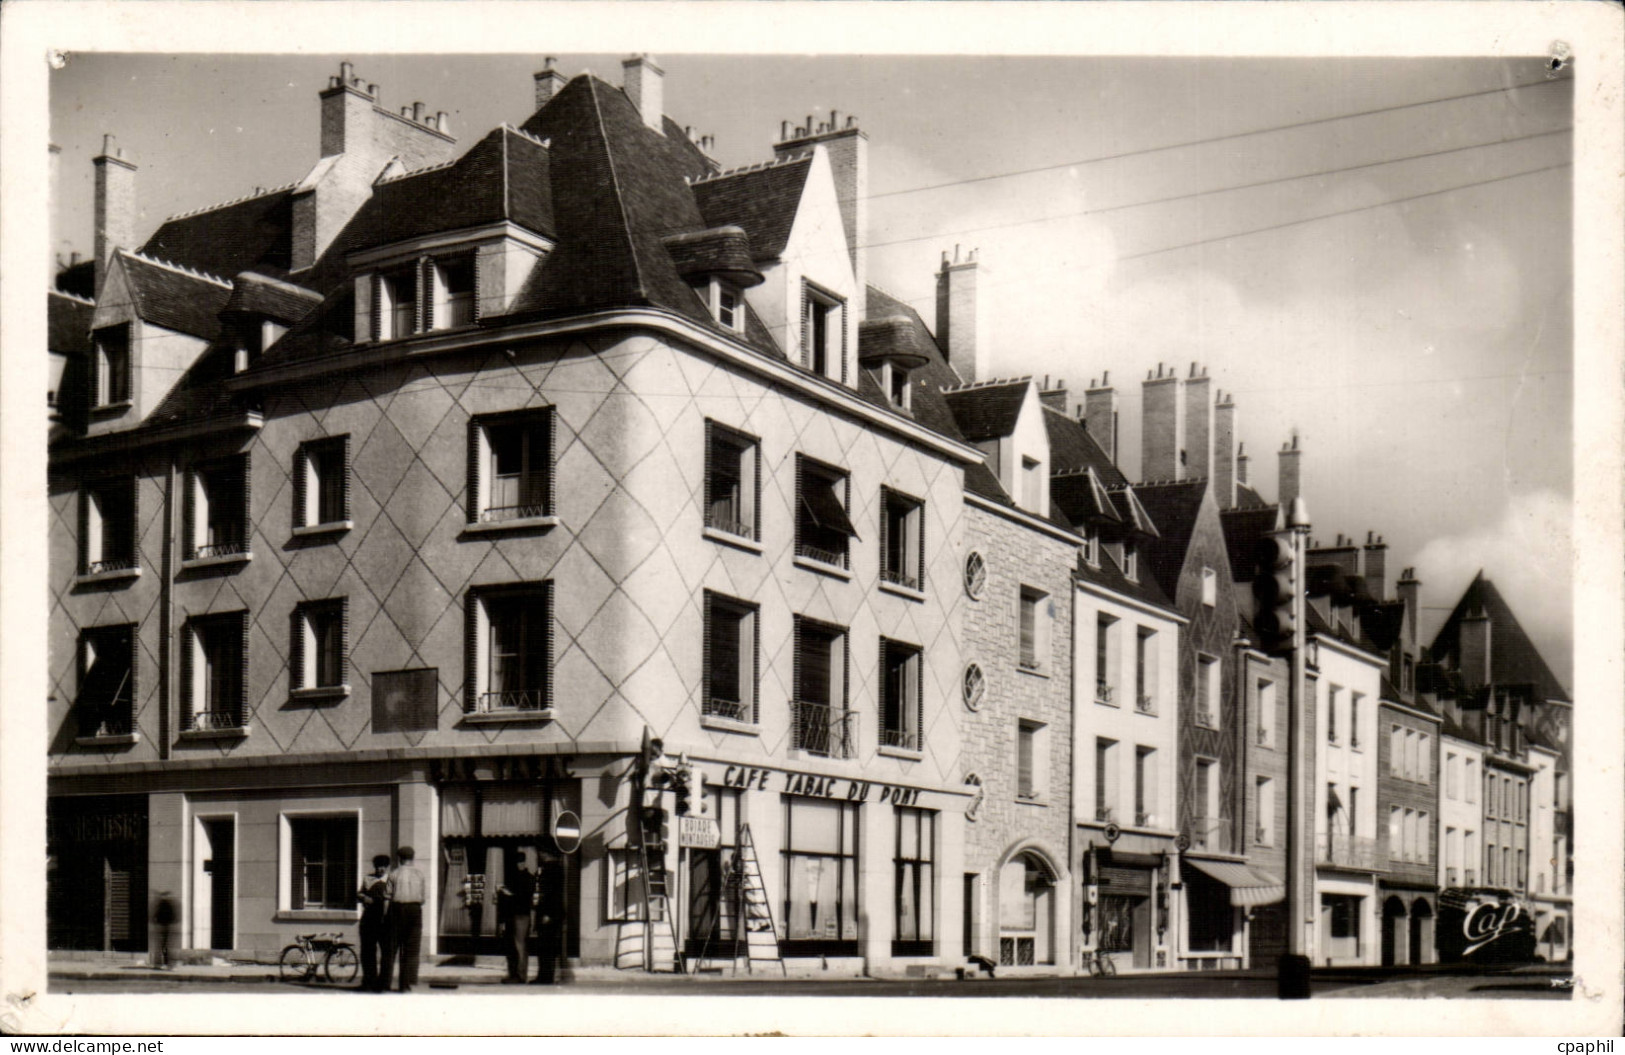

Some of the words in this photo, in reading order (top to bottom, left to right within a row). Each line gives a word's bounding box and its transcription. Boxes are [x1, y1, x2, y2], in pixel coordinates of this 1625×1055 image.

[723, 765, 771, 792] CAFE
[785, 773, 837, 798] TABAC
[847, 781, 871, 801] DU
